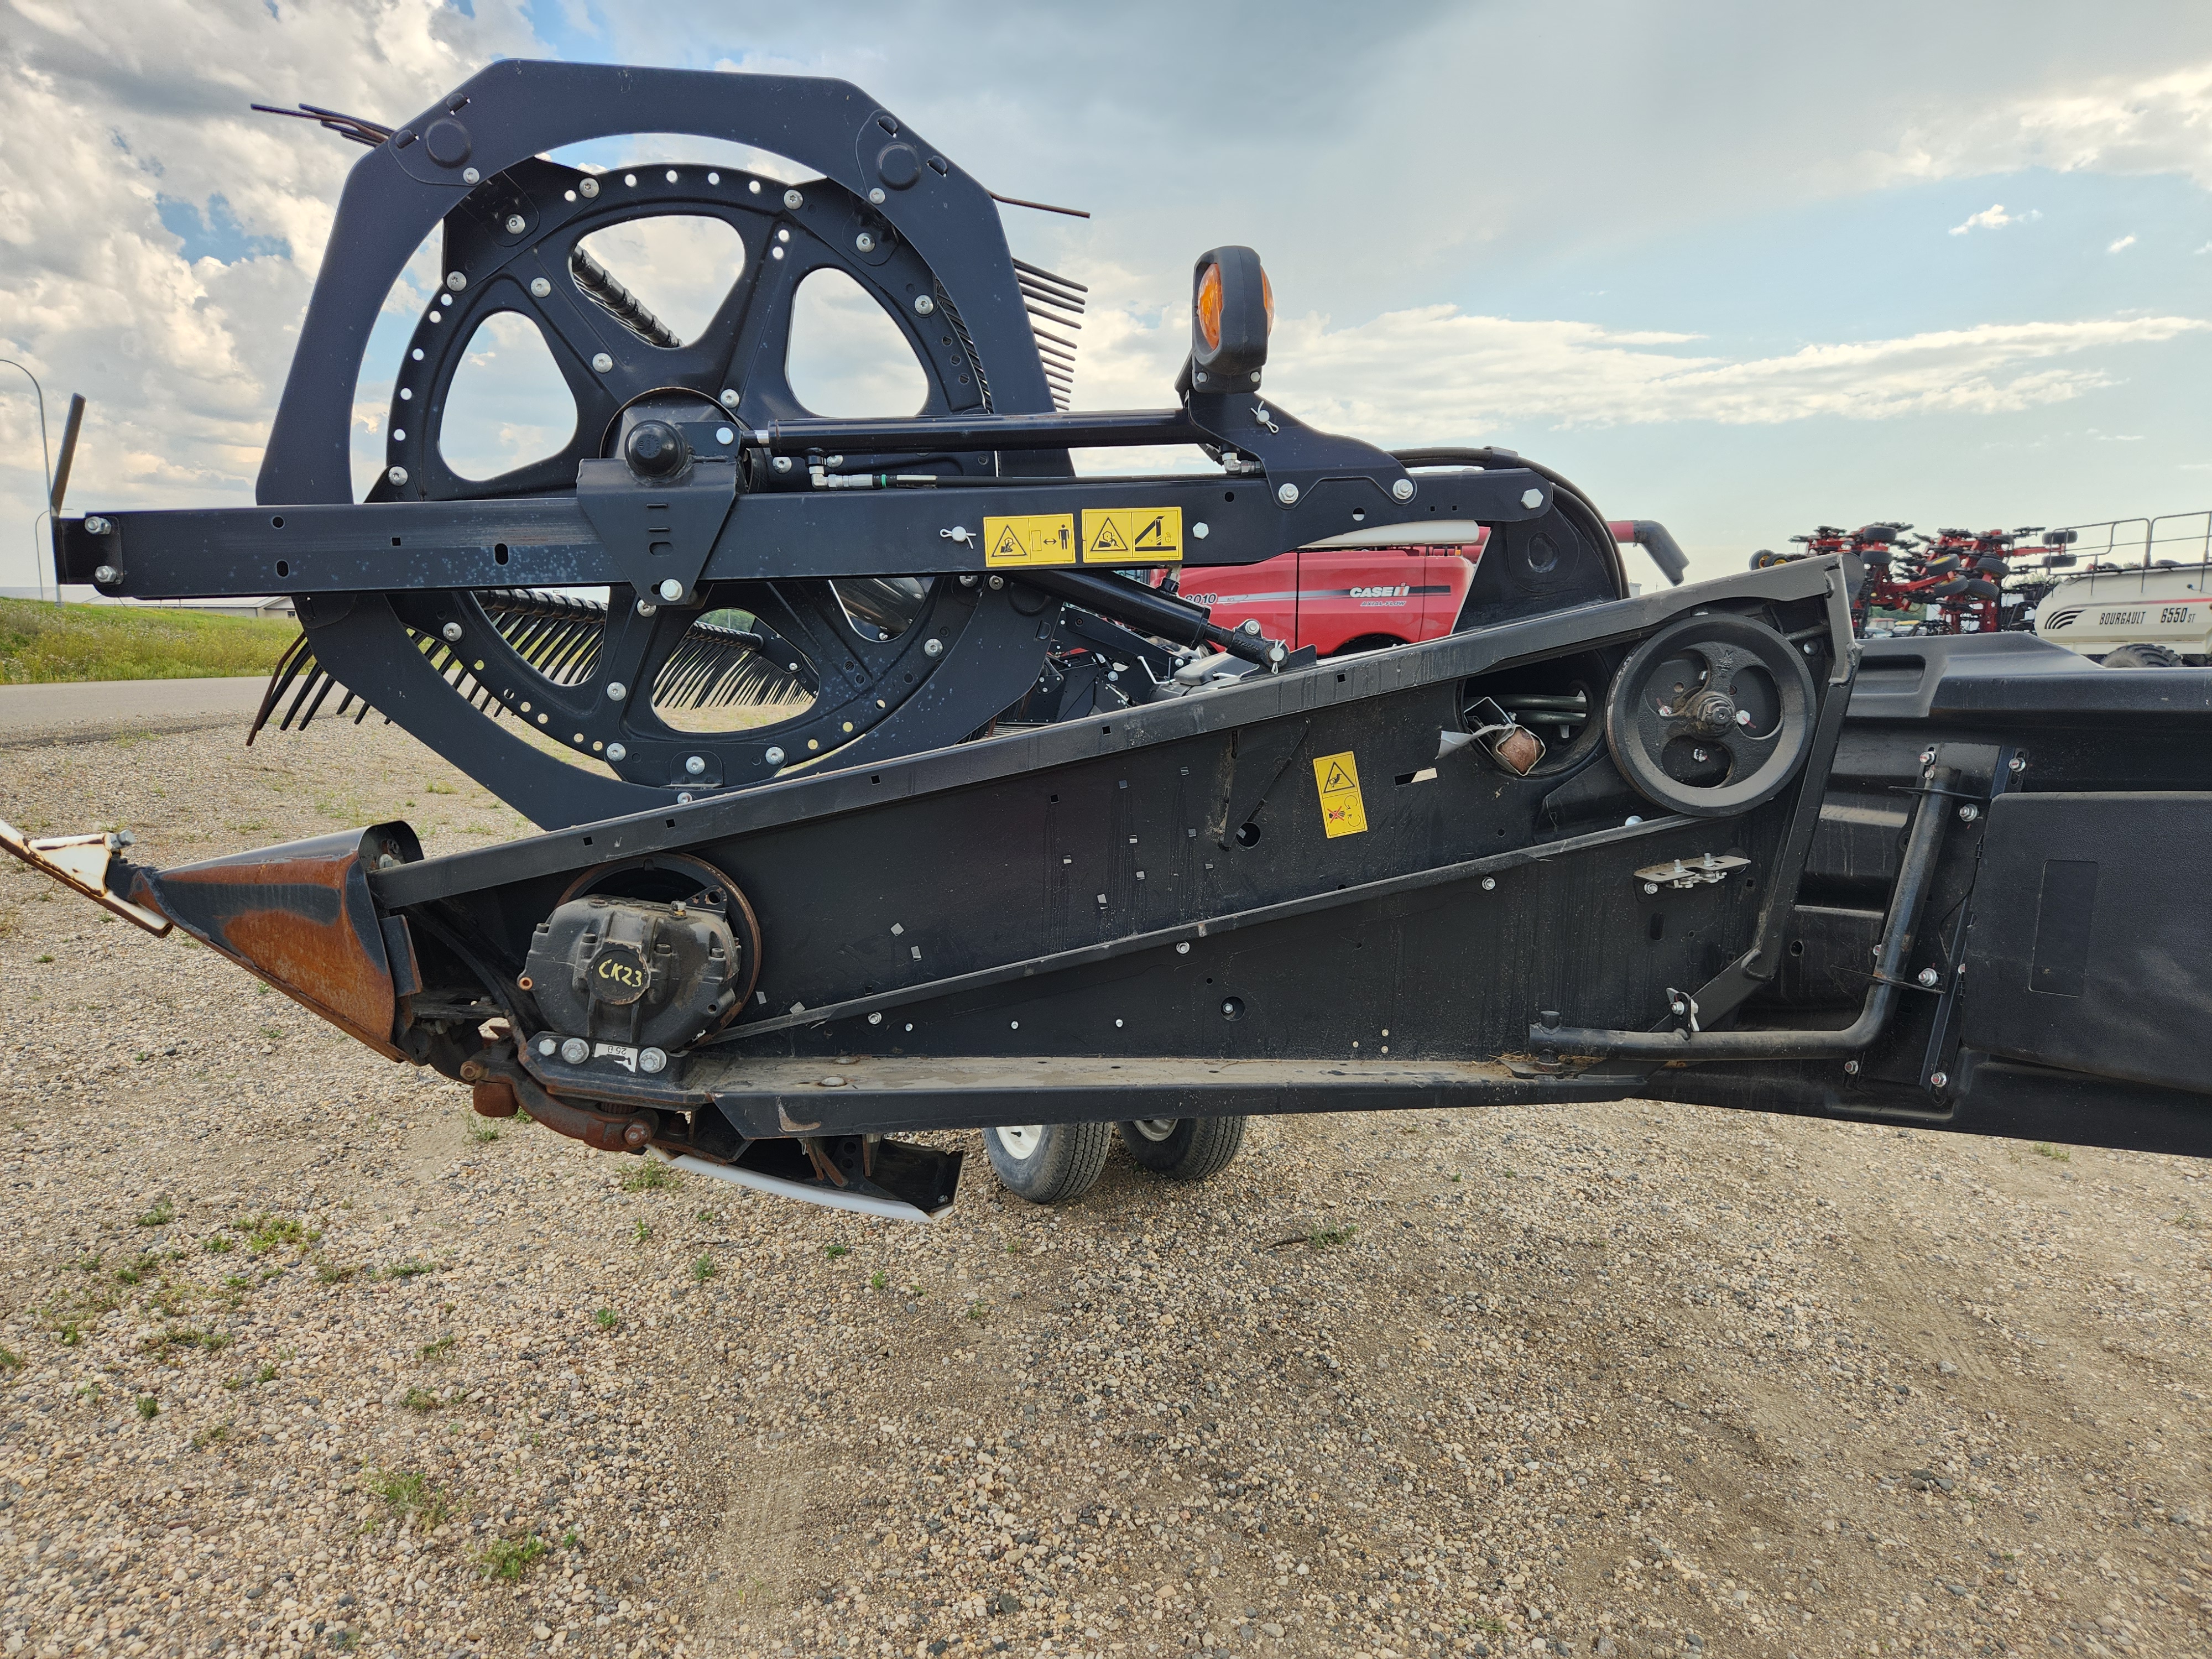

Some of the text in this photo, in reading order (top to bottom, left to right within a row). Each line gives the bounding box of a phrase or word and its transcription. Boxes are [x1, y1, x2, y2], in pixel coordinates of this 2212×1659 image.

[1349, 586, 1394, 598] CASE
[2099, 611, 2146, 625] BOURGAULT
[2160, 607, 2188, 623] 6550
[615, 1047, 627, 1055] 25
